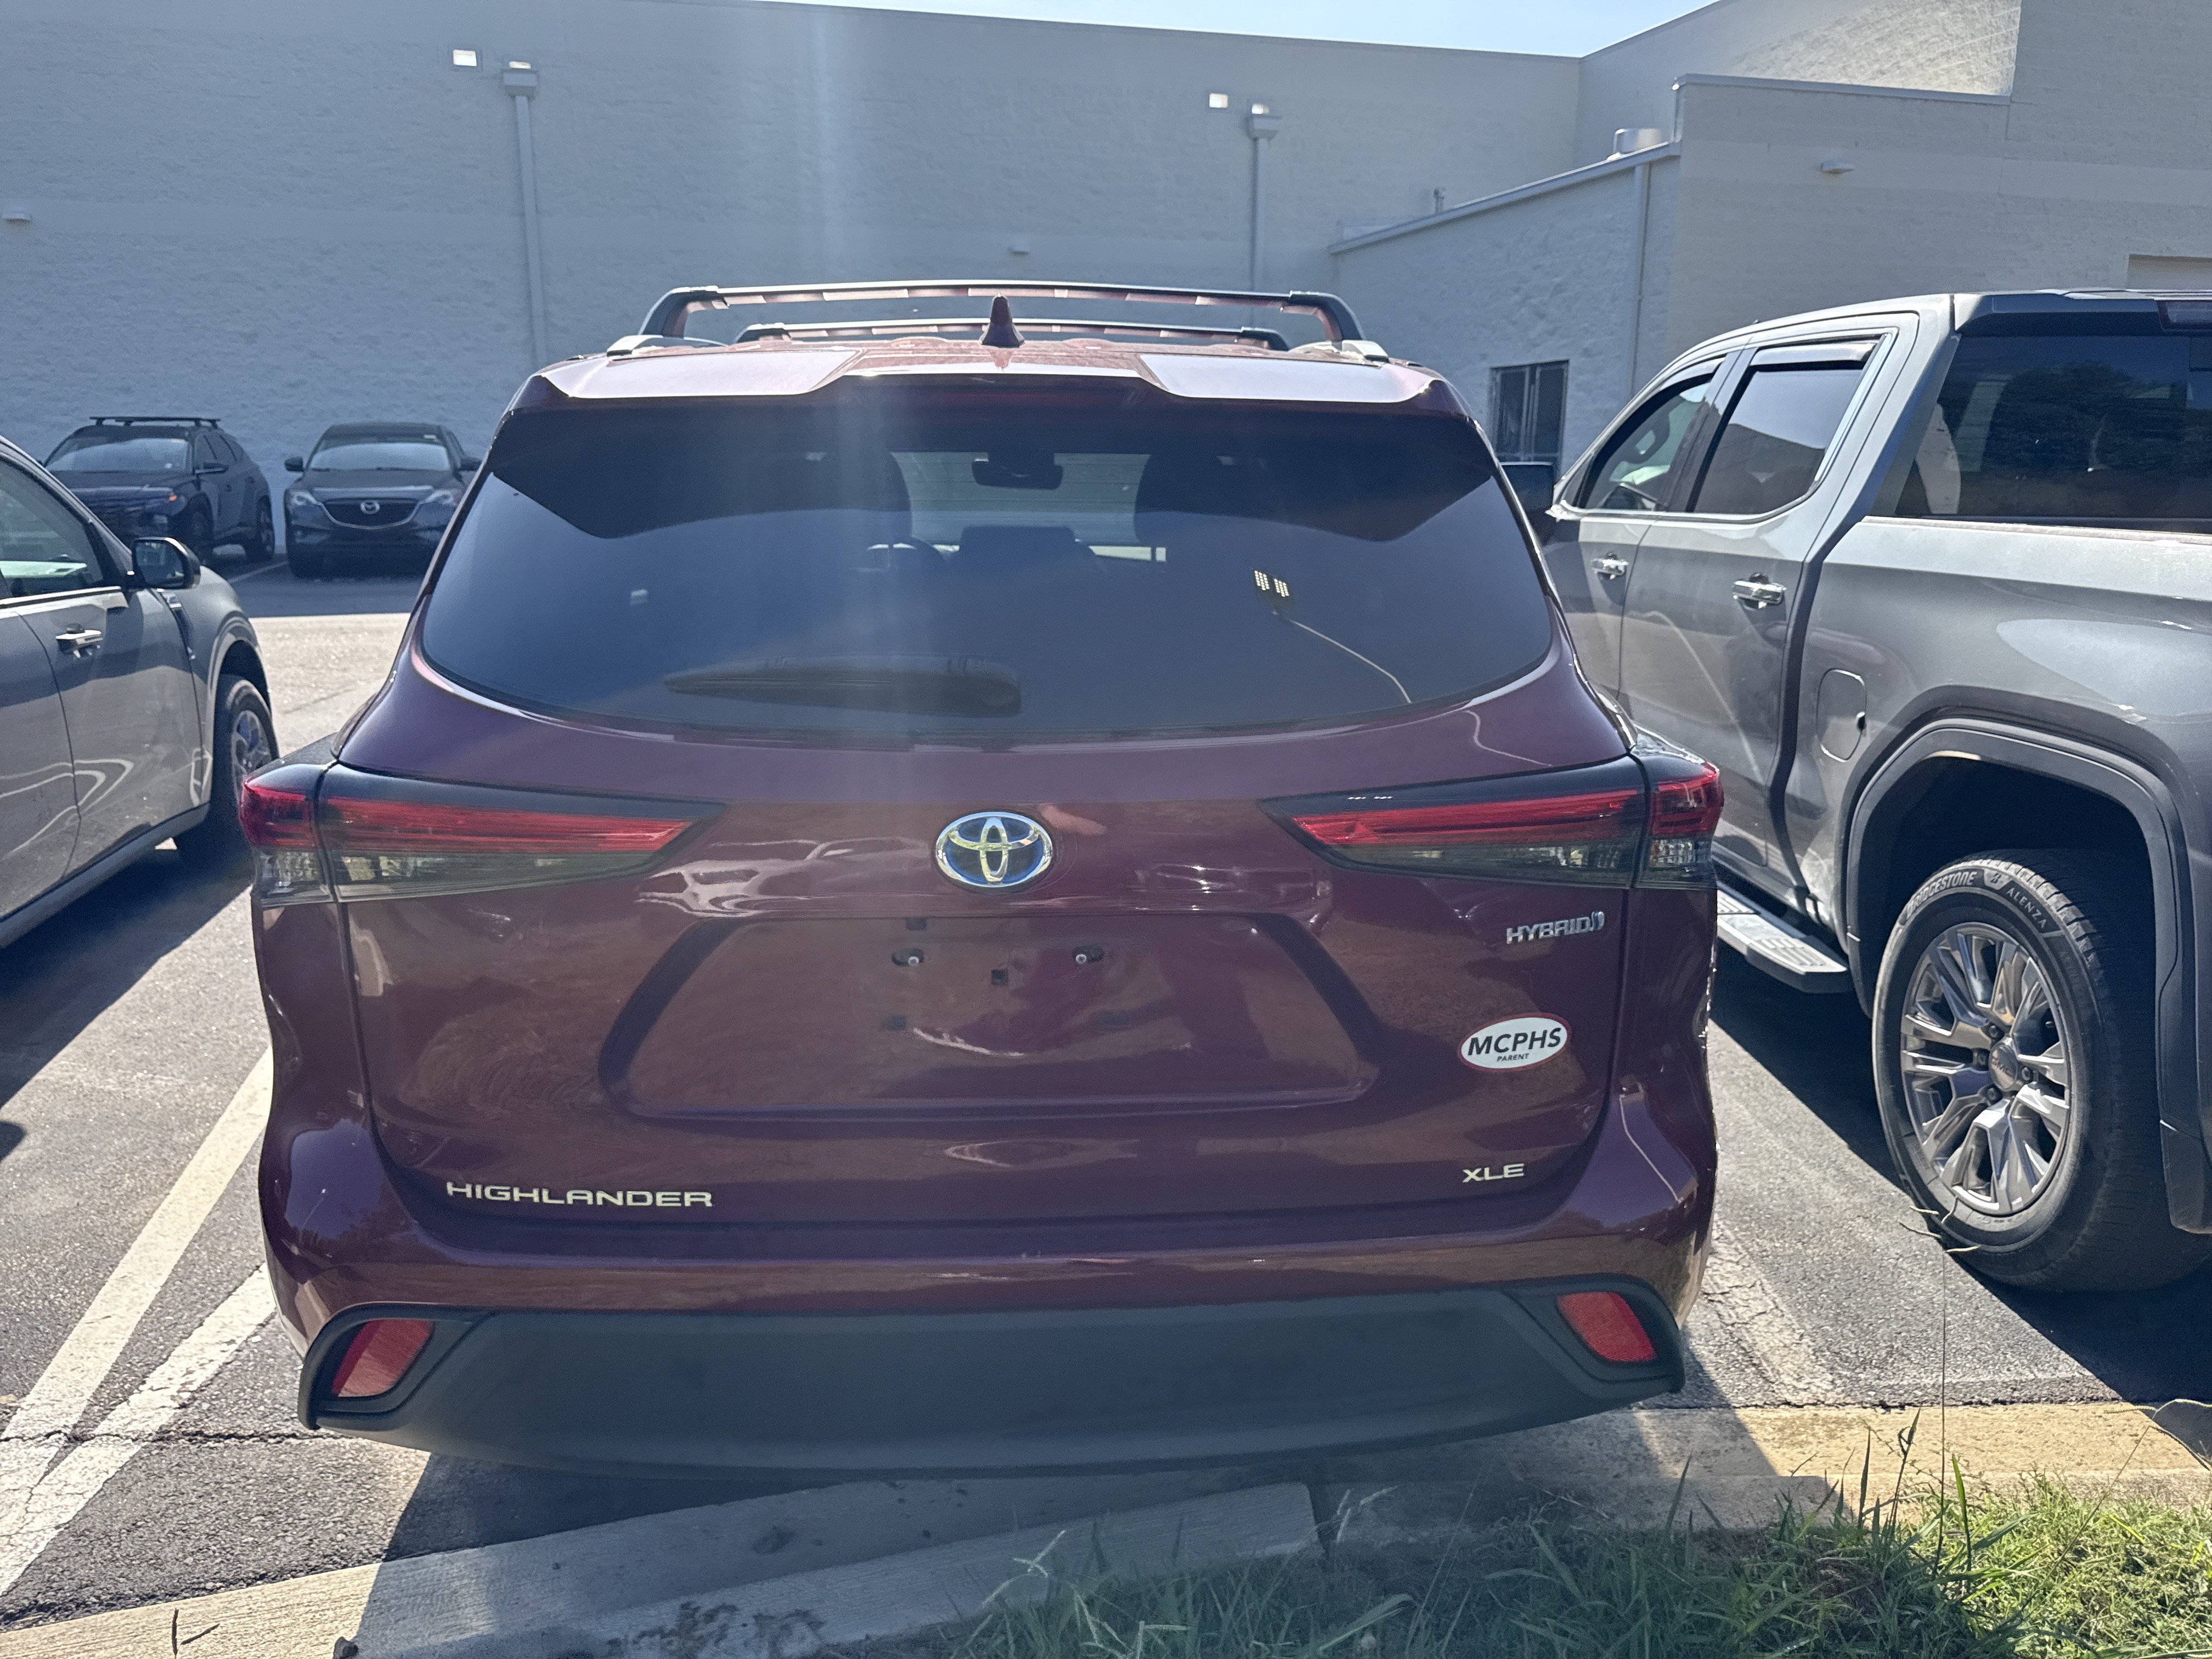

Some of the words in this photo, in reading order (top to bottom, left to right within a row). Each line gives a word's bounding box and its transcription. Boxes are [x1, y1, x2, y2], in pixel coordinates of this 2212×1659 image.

[1906, 871, 1977, 919] BRIDGESTONE
[2006, 887, 2047, 929] ALENZA
[1506, 916, 1593, 944] HYBRID
[1468, 1028, 1562, 1056] MCPHS
[1497, 1053, 1530, 1062] PARENT
[1462, 1163, 1525, 1183] XLE
[446, 1181, 713, 1207] HIGHLANDER
